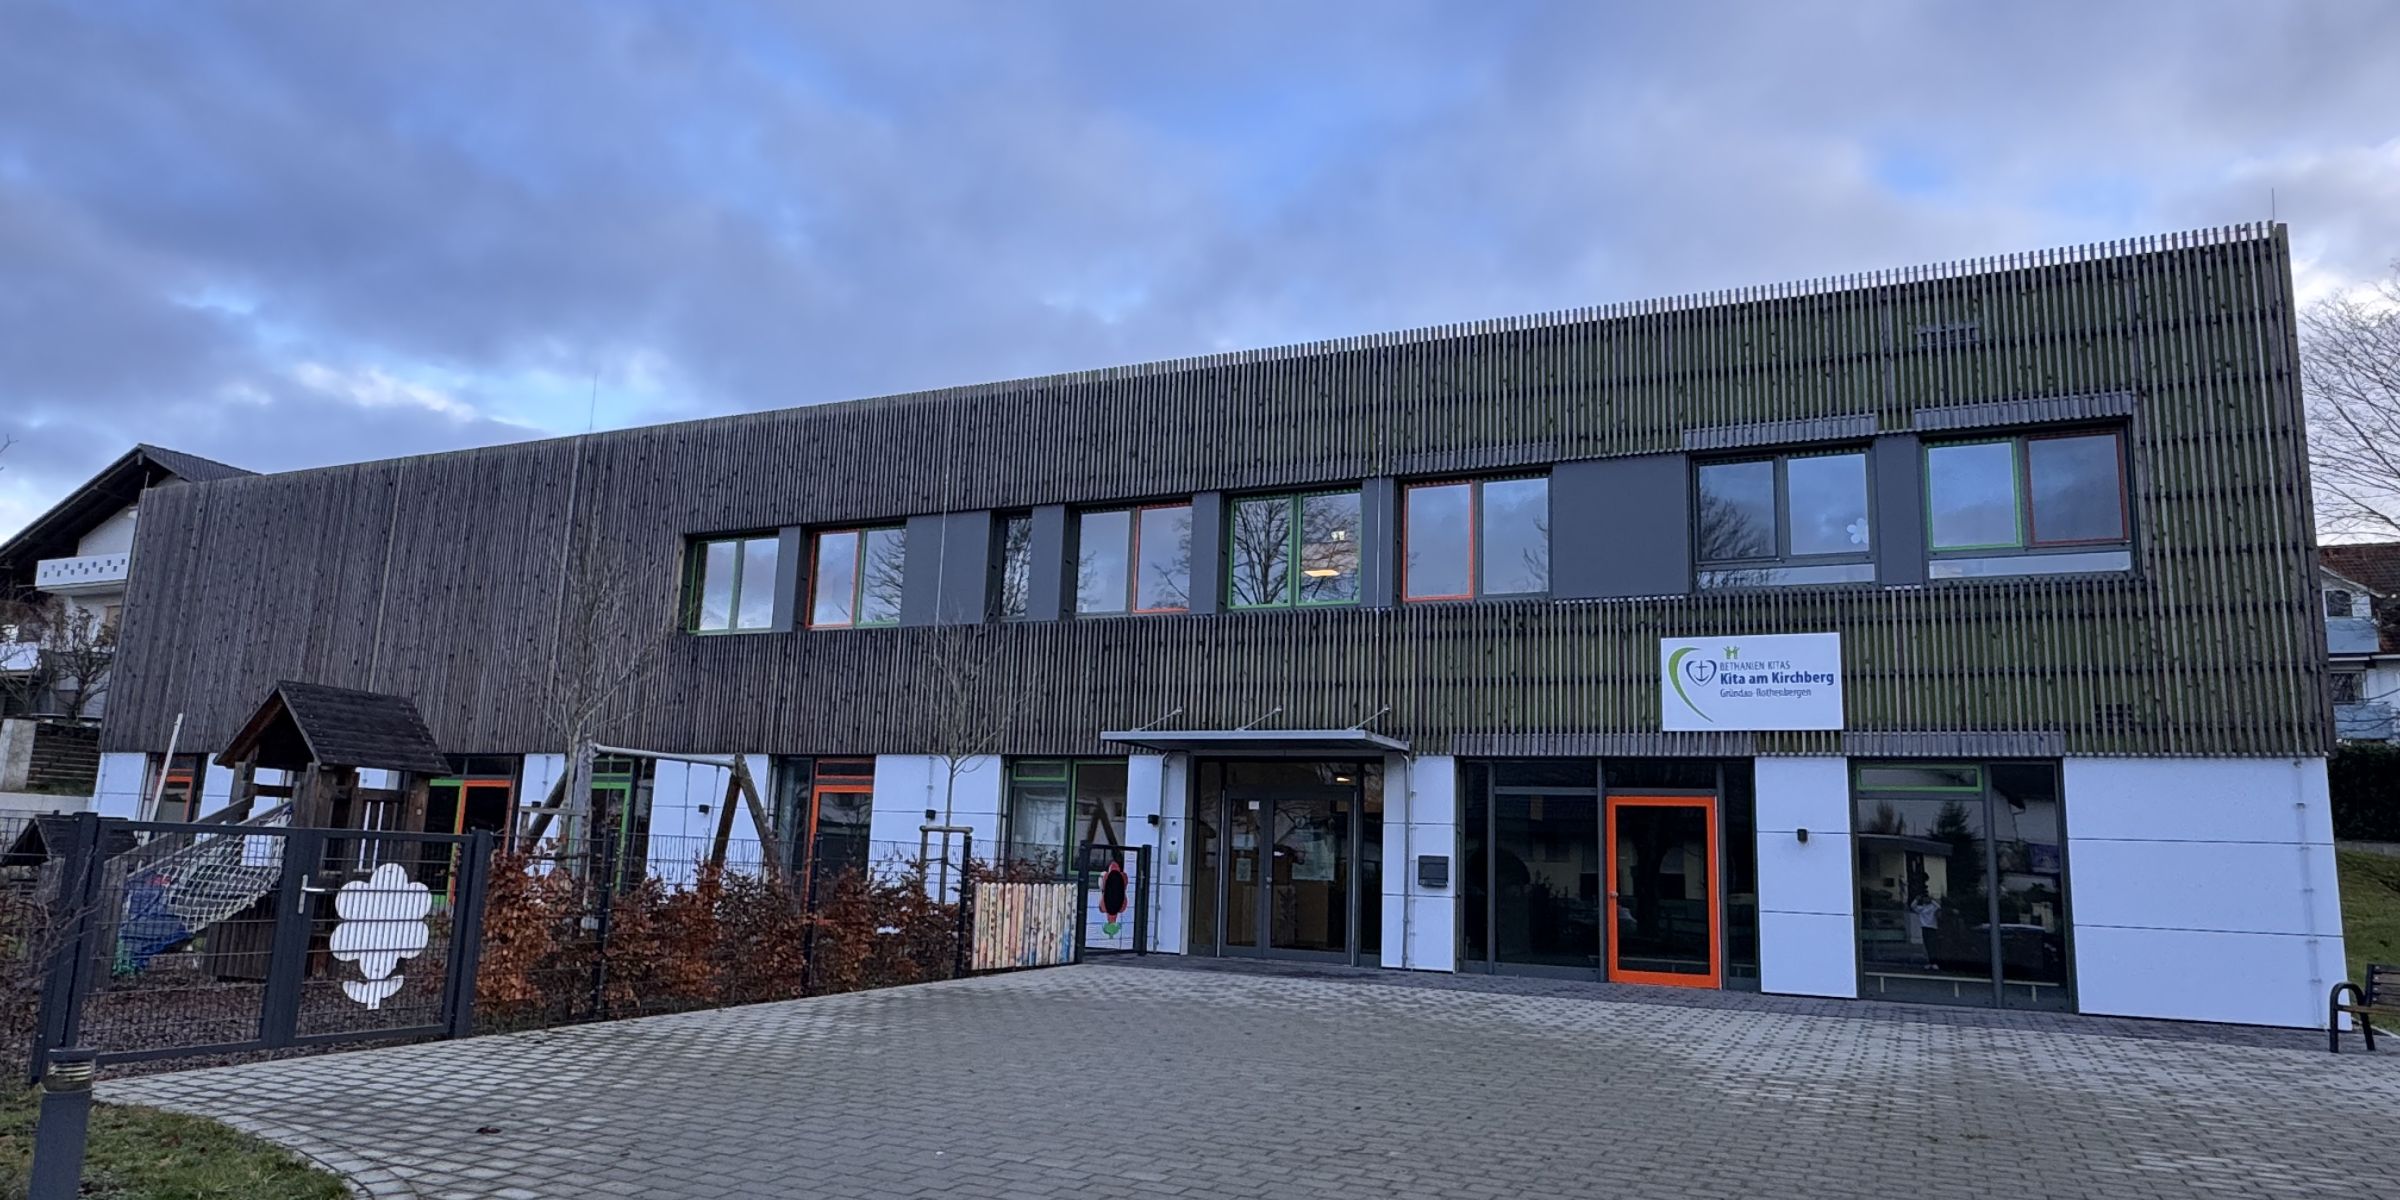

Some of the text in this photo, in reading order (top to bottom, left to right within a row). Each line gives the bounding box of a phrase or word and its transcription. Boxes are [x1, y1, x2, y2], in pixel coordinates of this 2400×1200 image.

[1720, 660, 1791, 671] BETHANIEN KITAS
[1720, 670, 1835, 686] Kita am Kirchberg
